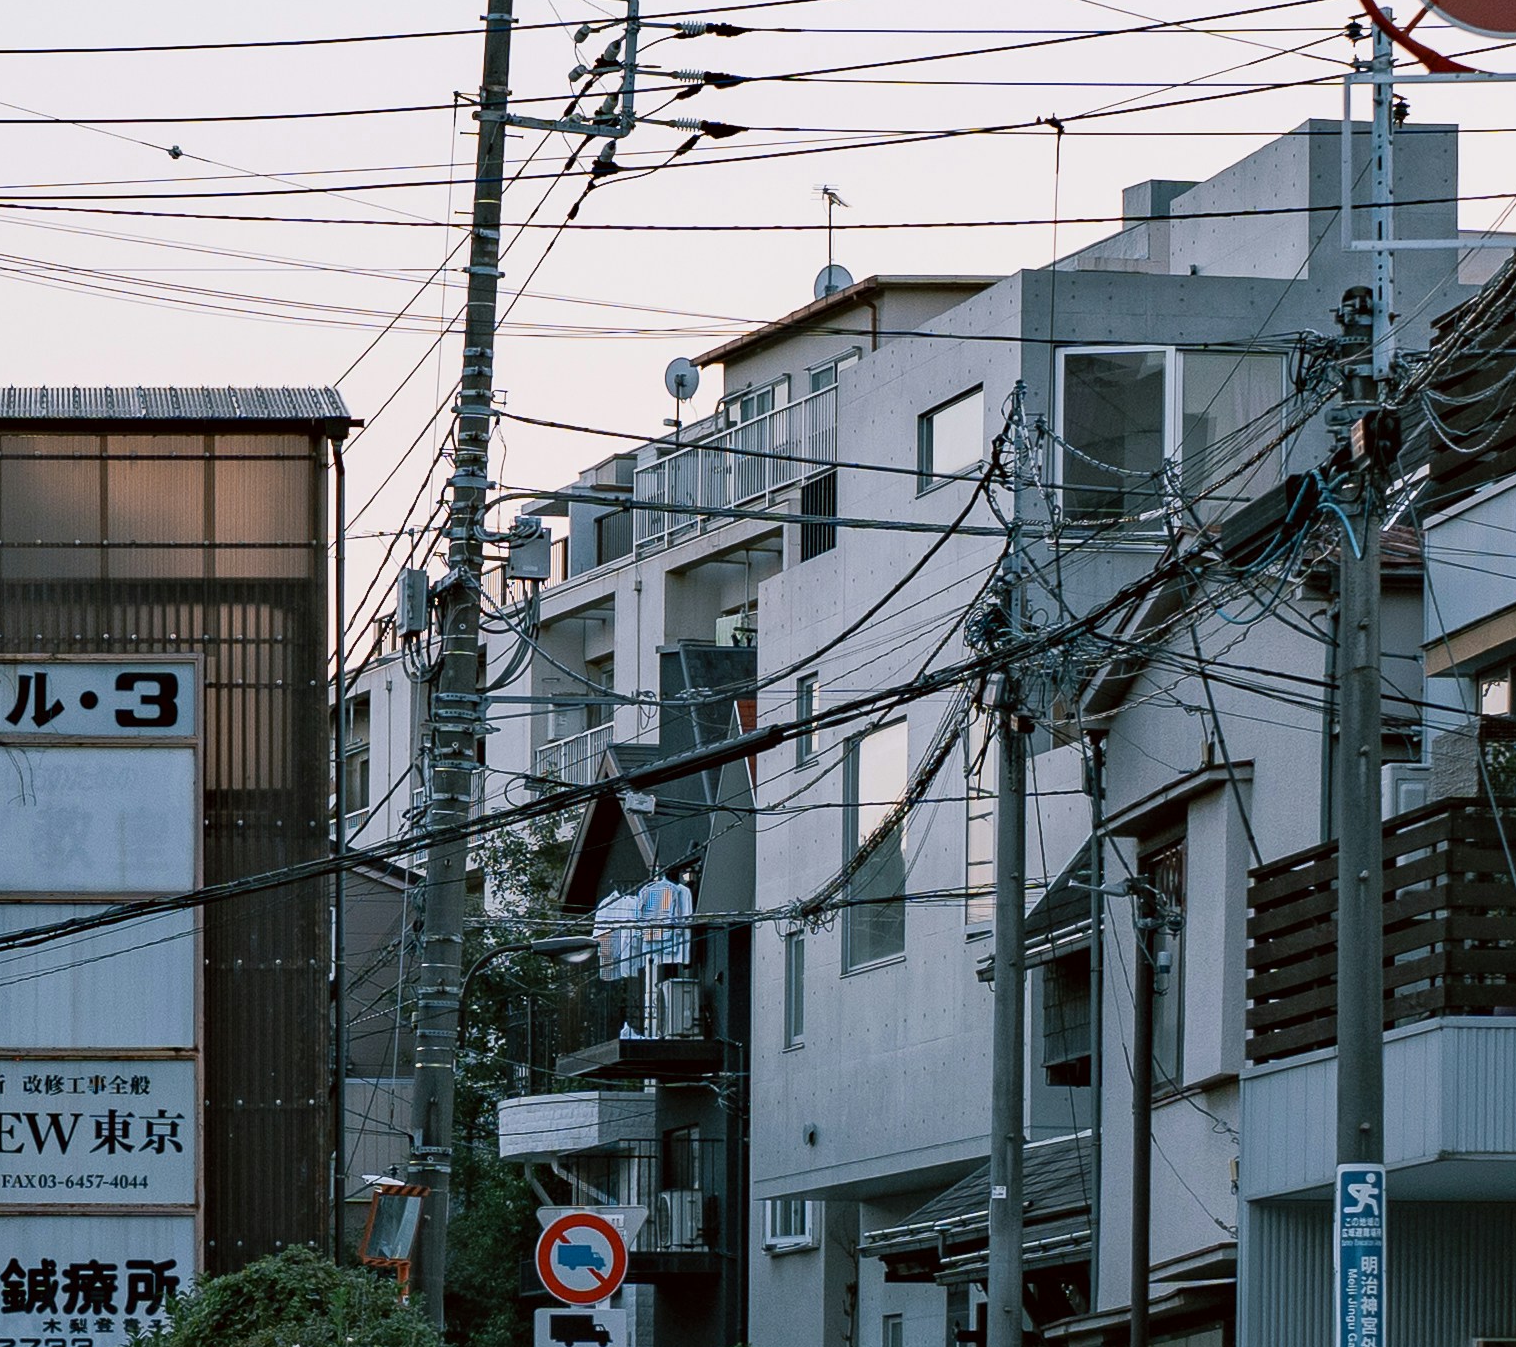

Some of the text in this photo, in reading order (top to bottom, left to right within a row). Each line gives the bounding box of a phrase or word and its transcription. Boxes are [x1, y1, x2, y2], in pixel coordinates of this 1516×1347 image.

[22, 1074, 151, 1096] 改修工事全般
[1, 1173, 149, 1189] FAX03-6457-4044
[1346, 1268, 1357, 1291] Meiji
[1346, 1294, 1357, 1330] Jingu
